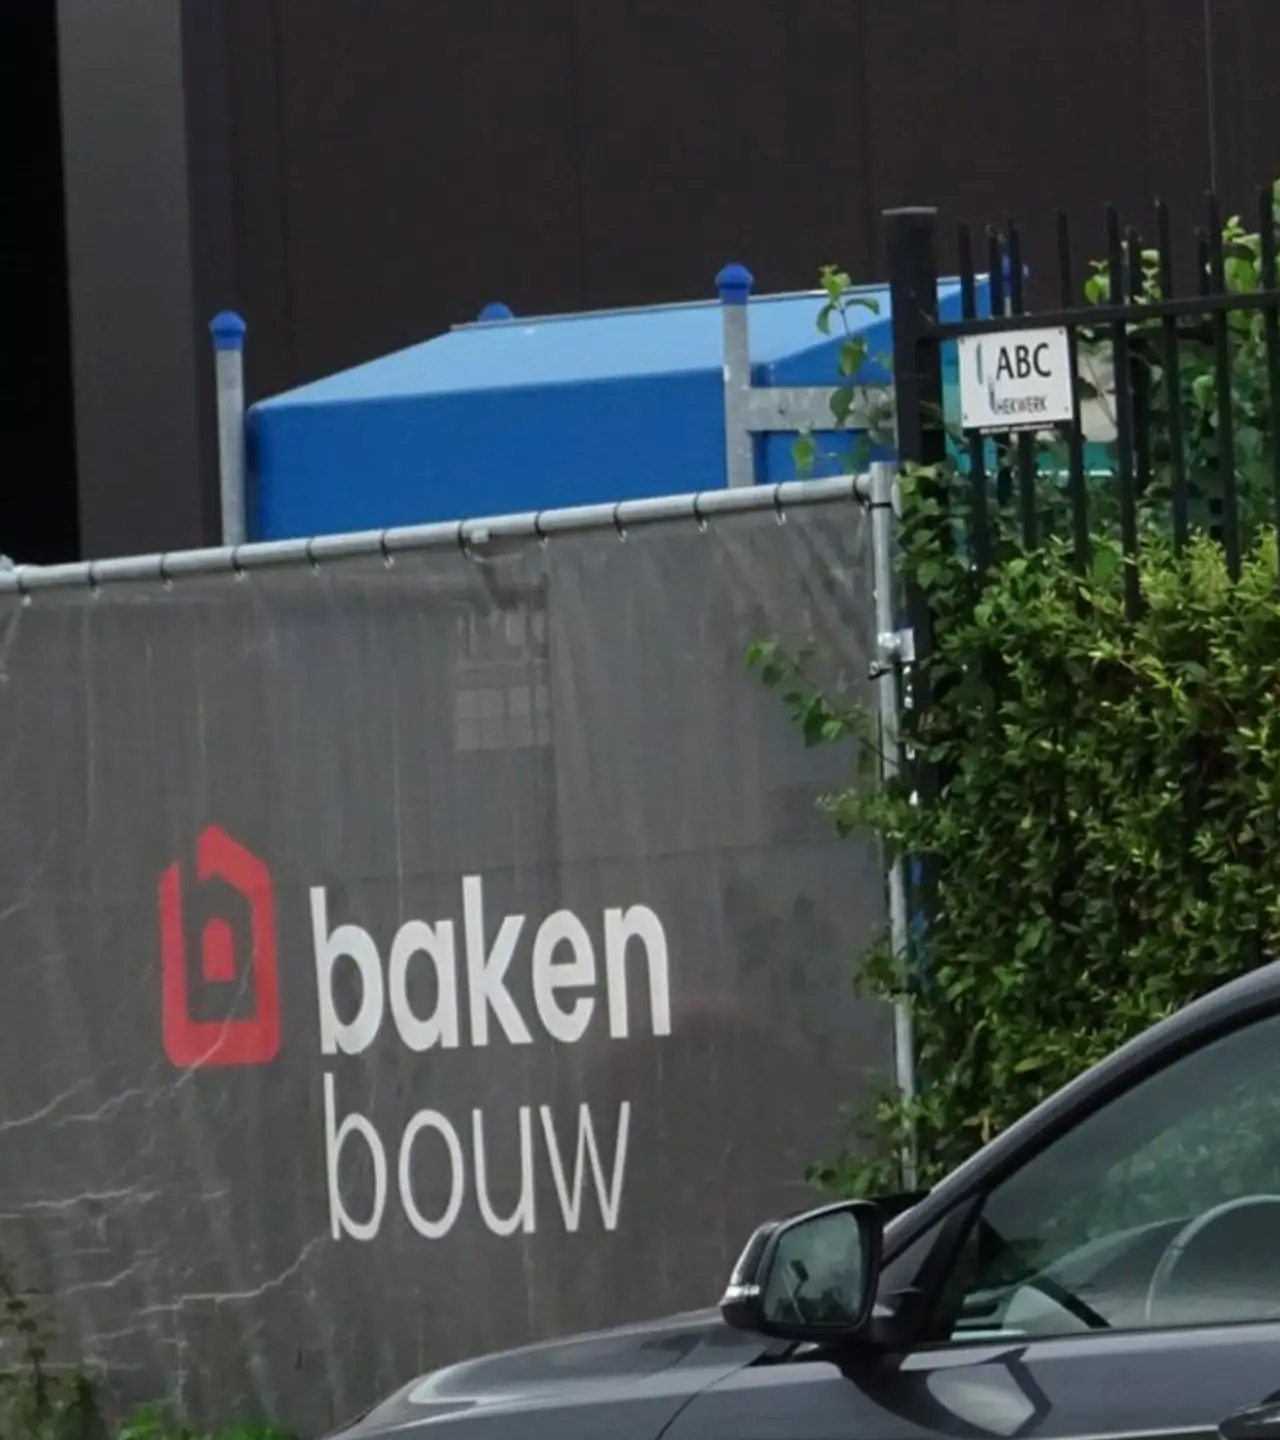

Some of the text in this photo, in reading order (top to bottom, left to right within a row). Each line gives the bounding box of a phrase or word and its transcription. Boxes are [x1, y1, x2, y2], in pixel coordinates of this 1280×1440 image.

[996, 342, 1052, 380] ABC
[310, 875, 671, 1055] baken
[324, 1072, 630, 1242] bouw
